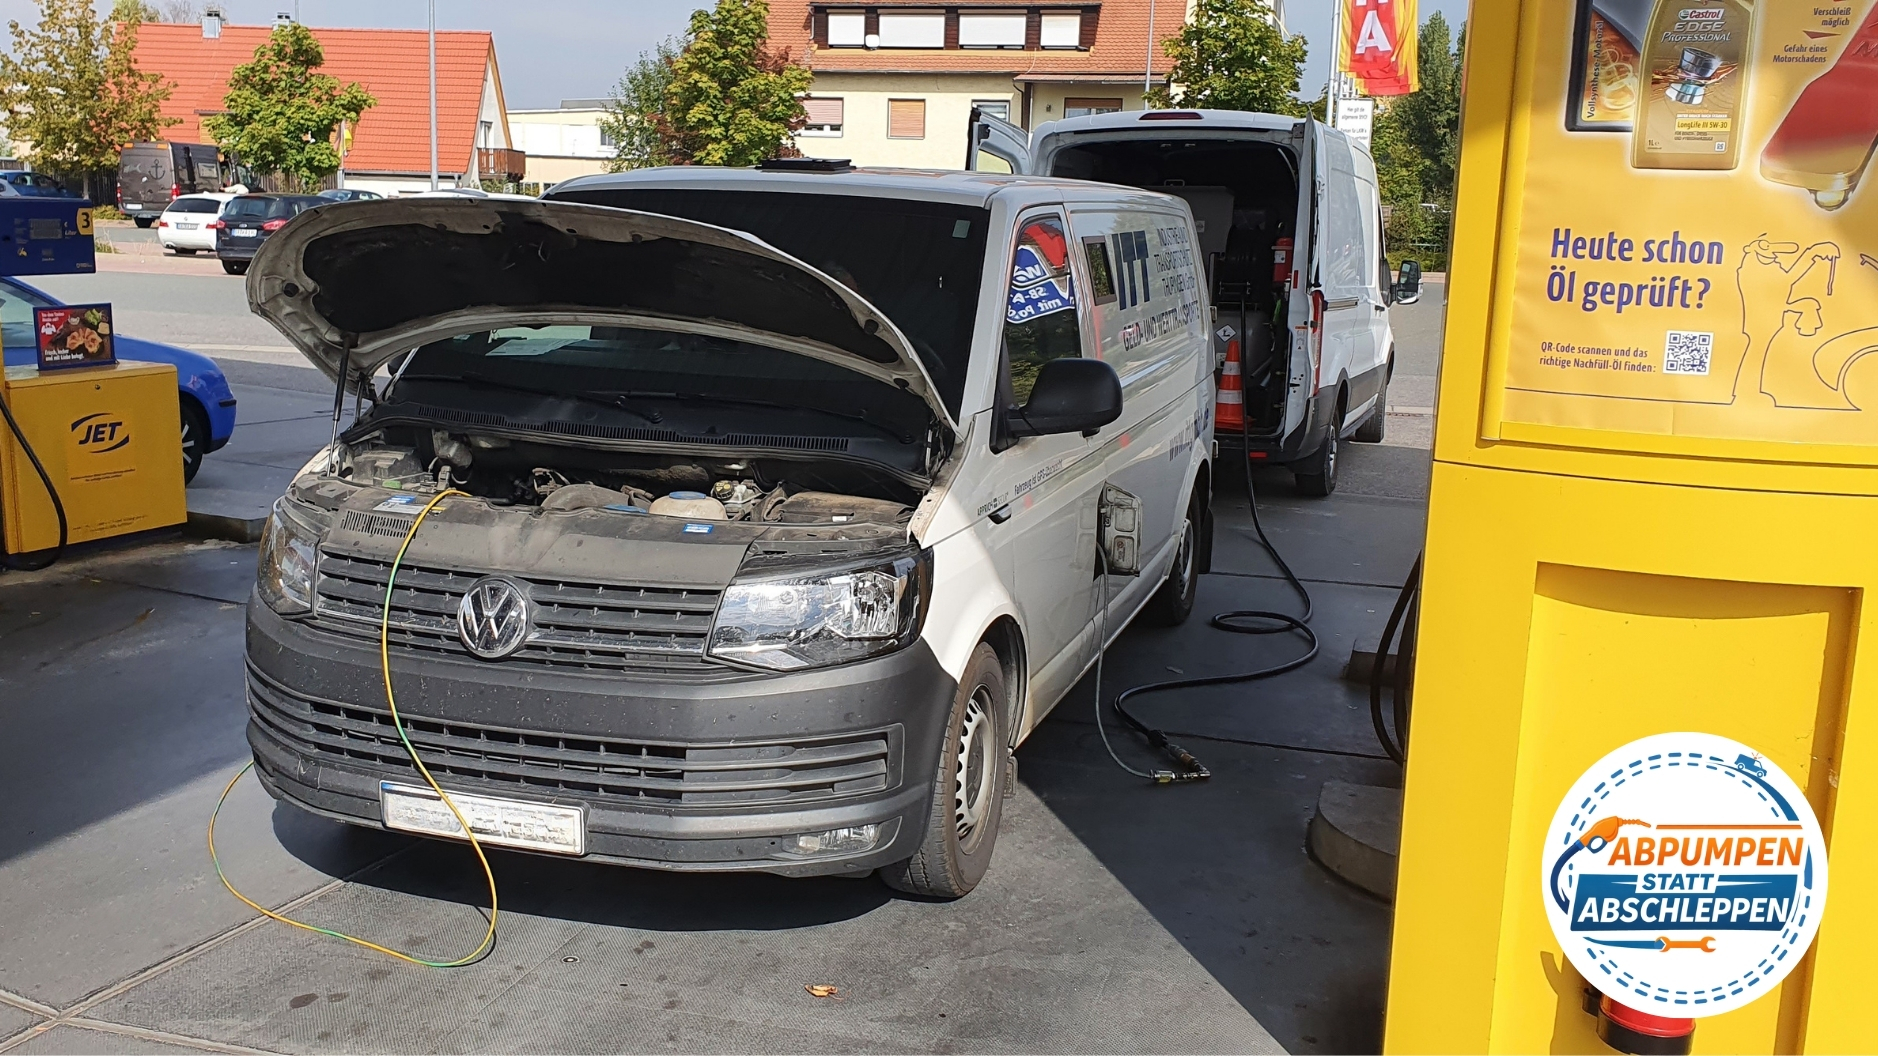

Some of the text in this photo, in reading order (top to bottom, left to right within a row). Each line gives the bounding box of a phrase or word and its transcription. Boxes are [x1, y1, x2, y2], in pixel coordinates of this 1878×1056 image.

[1689, 10, 1721, 20] Castrol
[1813, 7, 1851, 16] Verschleiß
[1355, 0, 1392, 54] A
[1674, 21, 1725, 32] EDGE
[1821, 18, 1850, 27] möglich
[1784, 45, 1808, 53] Gefahr
[1772, 54, 1827, 63] Motorschadens
[1587, 20, 1604, 118] Vollsynthese-Motoröl
[1677, 121, 1701, 130] LongLife
[81, 212, 90, 228] 3
[1551, 228, 1724, 265] Heute schon
[1111, 230, 1150, 311] ITT
[1547, 265, 1711, 314] Öl geprüft?
[1541, 341, 1648, 358] QR-Code scannen und das
[1539, 355, 1656, 373] richtige Nachfüll-Öl finden:
[78, 421, 123, 445] JET
[1014, 478, 1032, 496] Fahrzeug
